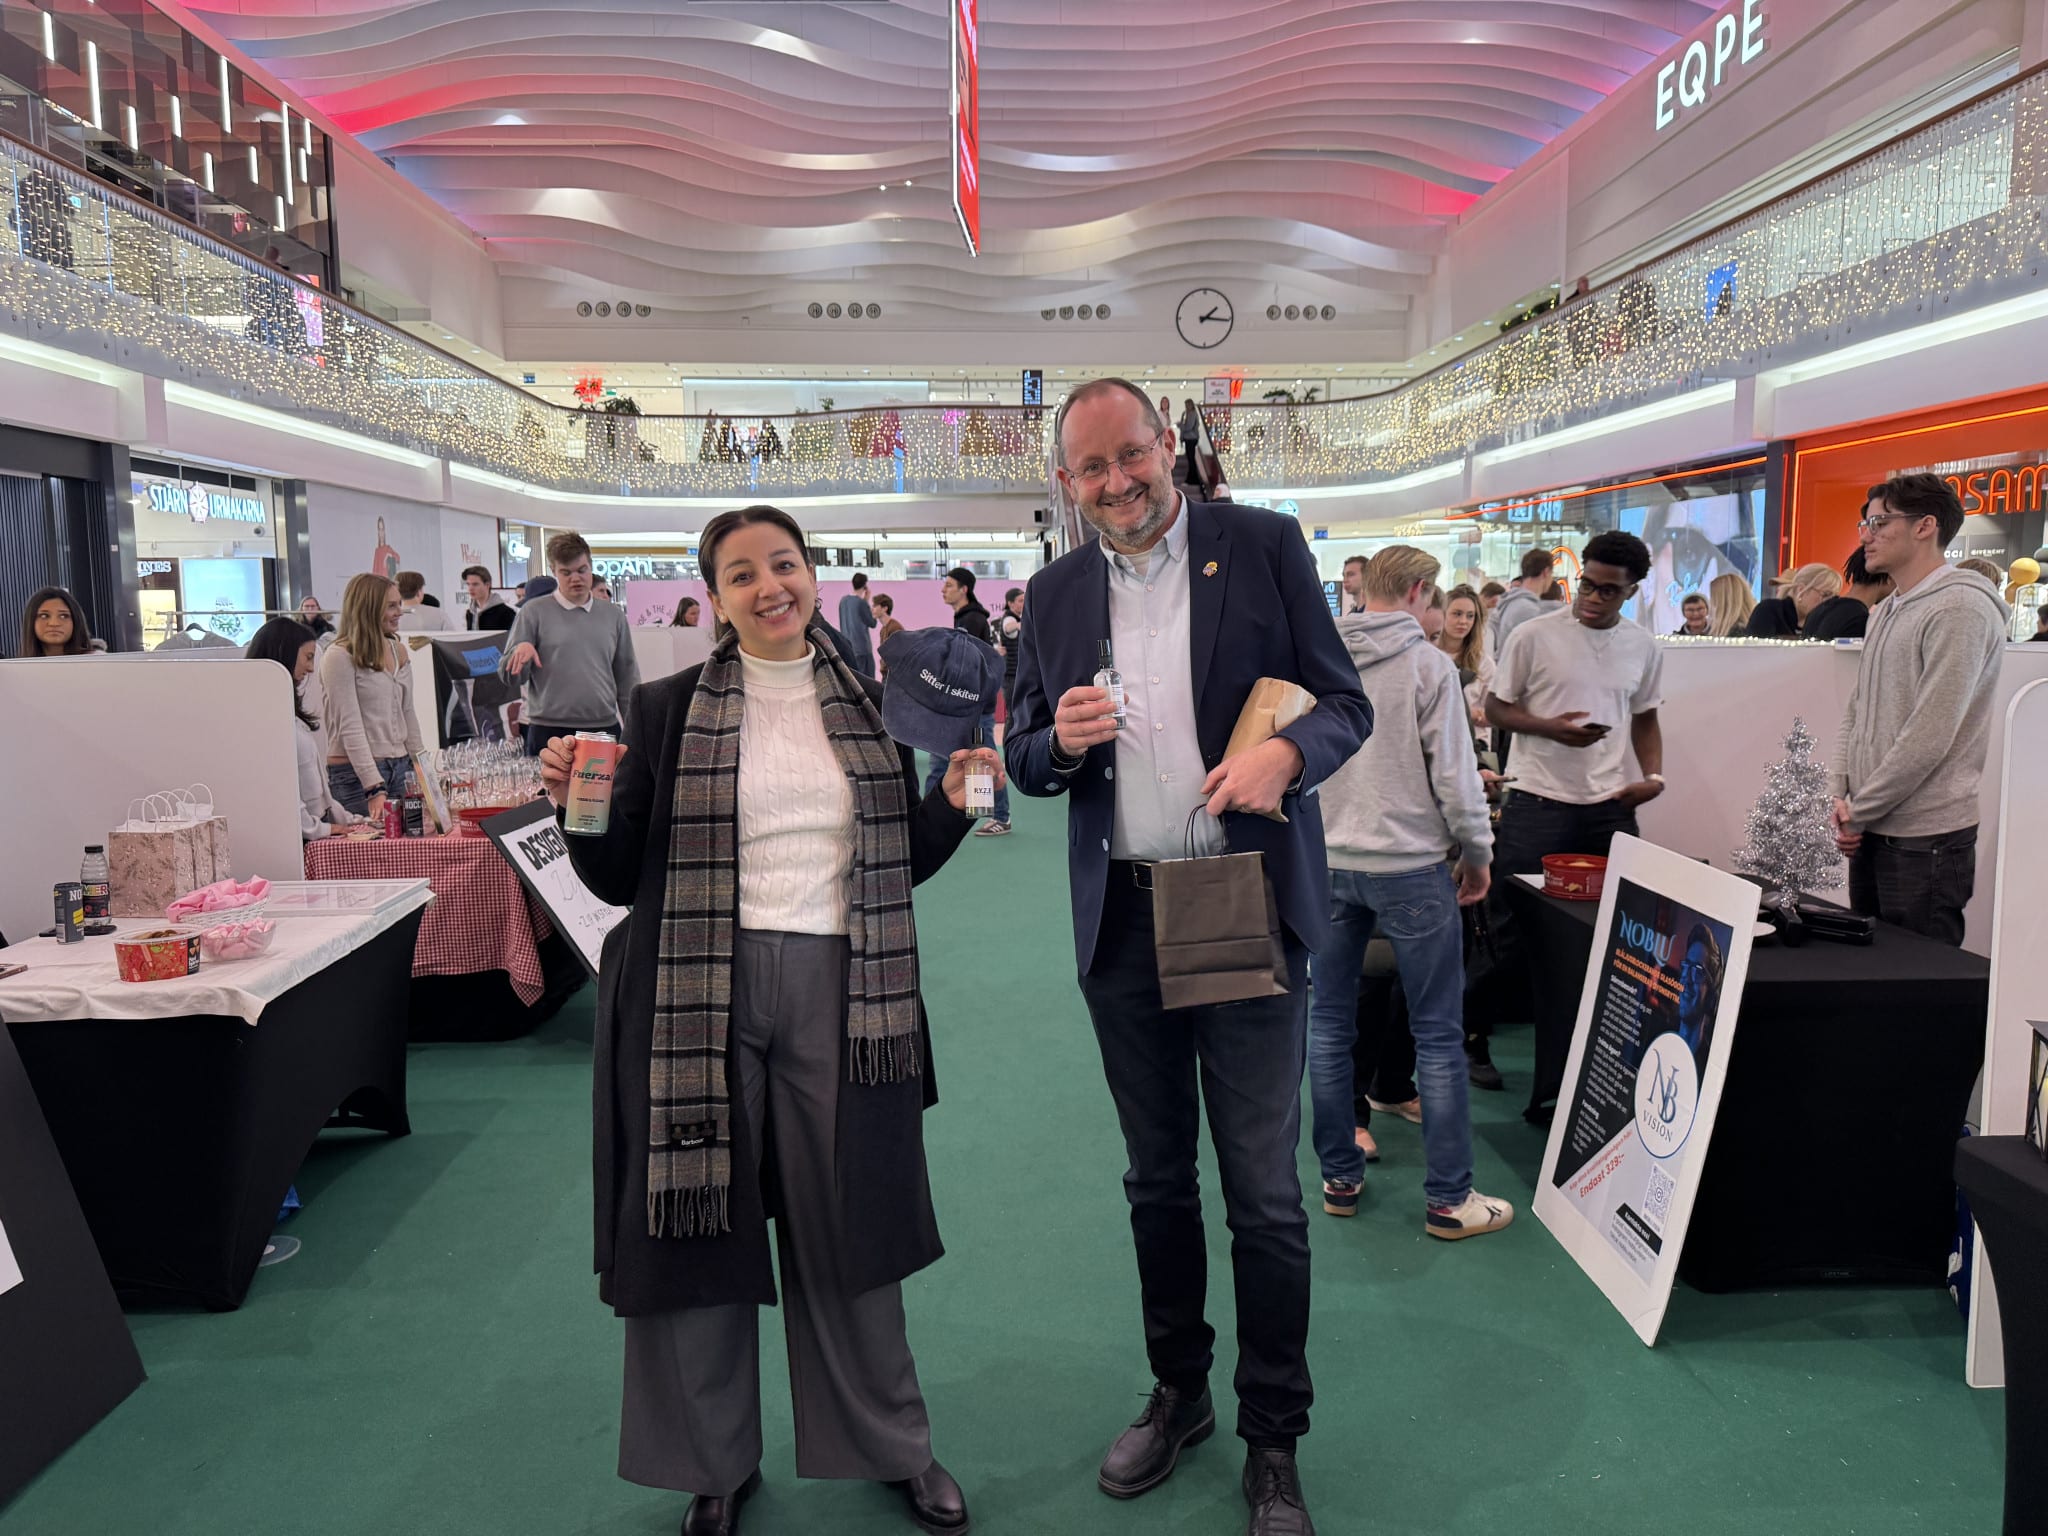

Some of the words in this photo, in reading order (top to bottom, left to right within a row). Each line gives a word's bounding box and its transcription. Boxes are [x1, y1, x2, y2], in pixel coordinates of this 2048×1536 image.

[1656, 0, 1764, 131] EQPE
[208, 493, 266, 524] URMAKARNA
[1970, 548, 2006, 557] GIVENCHY
[652, 604, 666, 614] THE
[919, 668, 945, 691] Sitter
[950, 687, 980, 702] skiten
[1620, 910, 1677, 967] NOBLU
[681, 1137, 705, 1146] Barbour
[1643, 1109, 1674, 1143] VISION
[1579, 1169, 1605, 1198] Endast
[1604, 1153, 1625, 1175] 329:-
